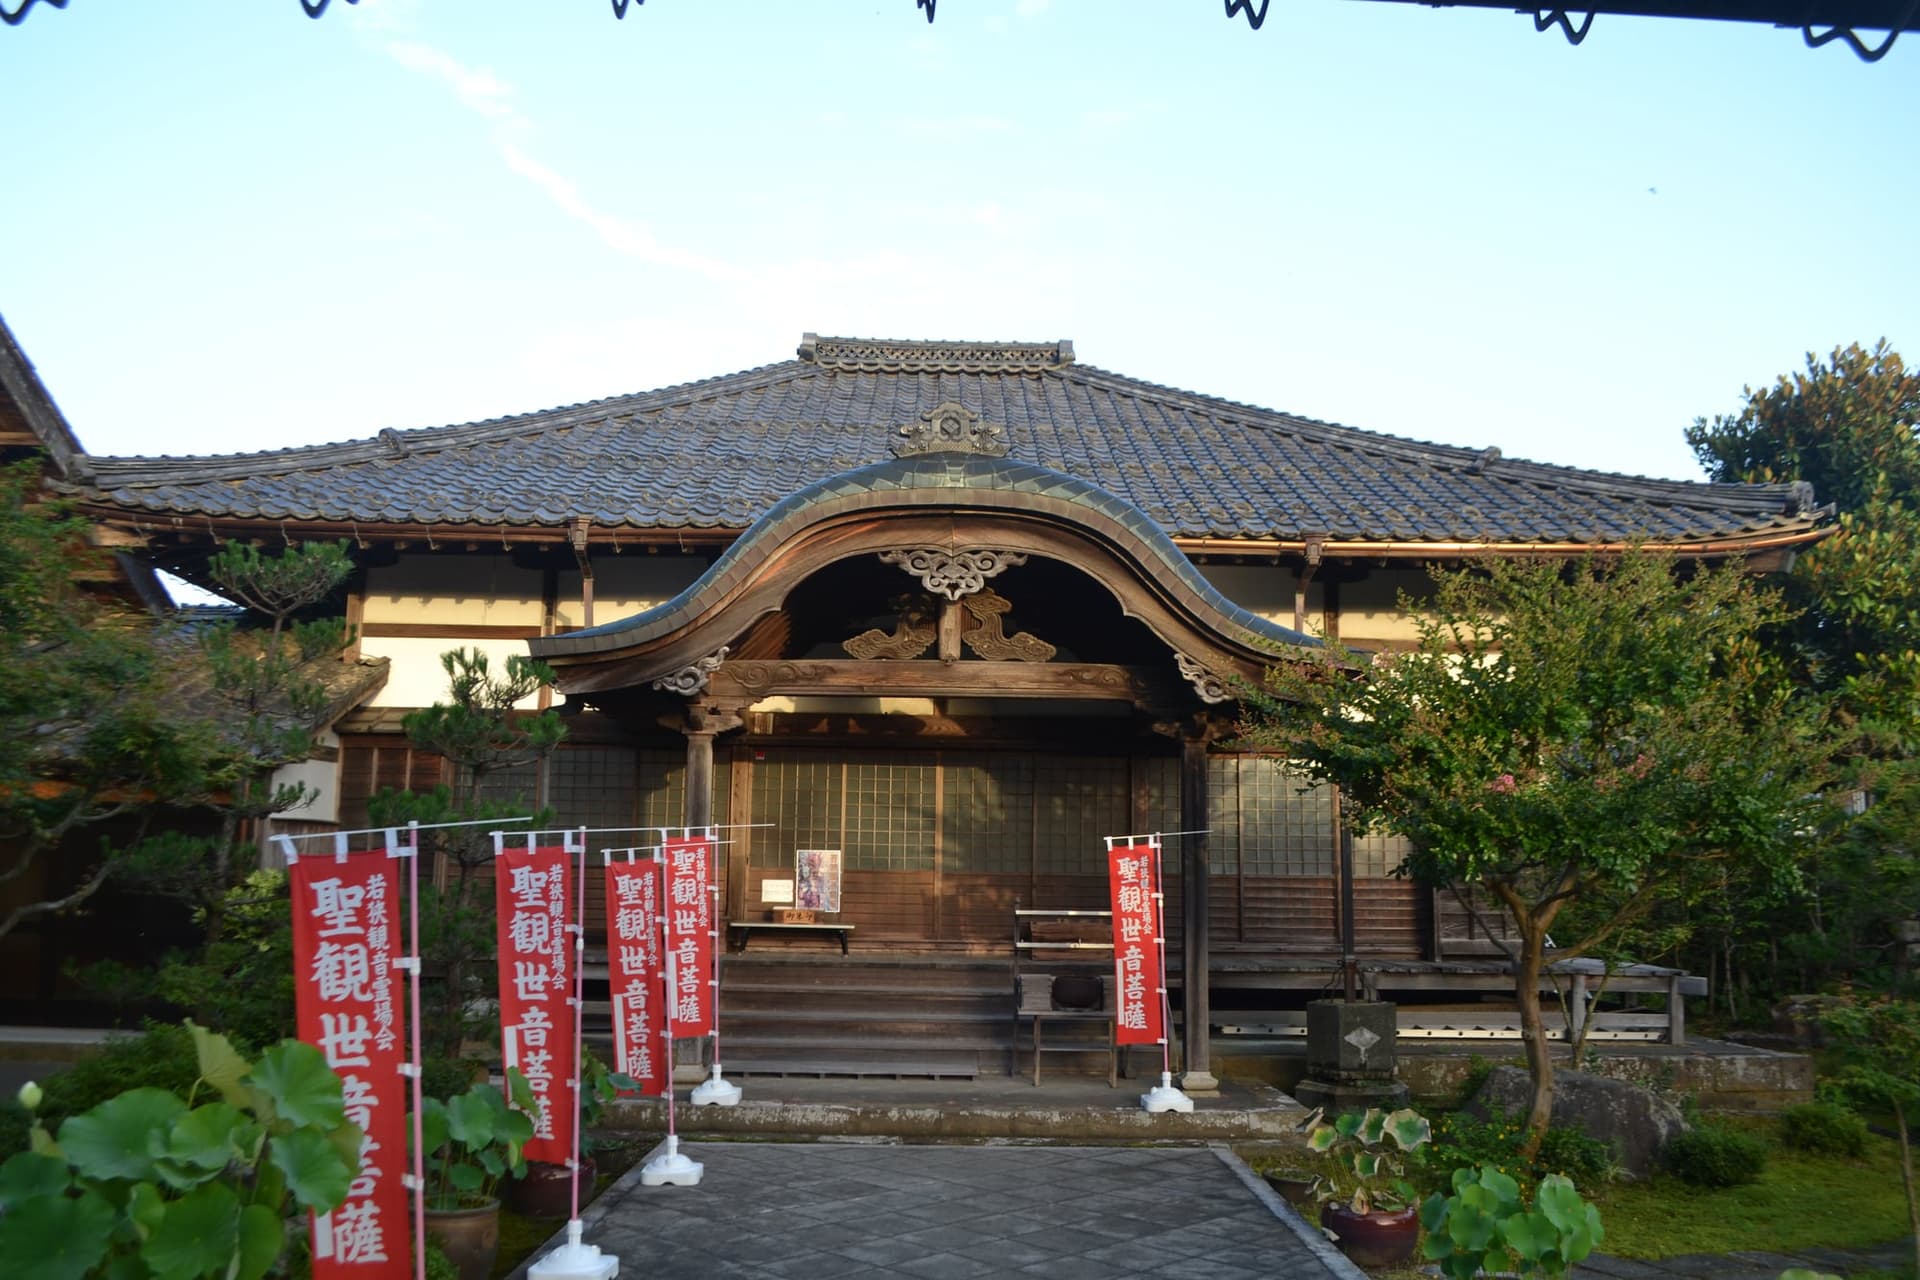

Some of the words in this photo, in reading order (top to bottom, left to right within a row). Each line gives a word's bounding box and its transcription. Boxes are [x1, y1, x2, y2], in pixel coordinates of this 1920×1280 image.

[615, 874, 655, 1079] 聖観世音菩薩
[671, 848, 702, 1023] 聖観世音菩薩
[1116, 856, 1148, 1029] 聖観世音菩薩
